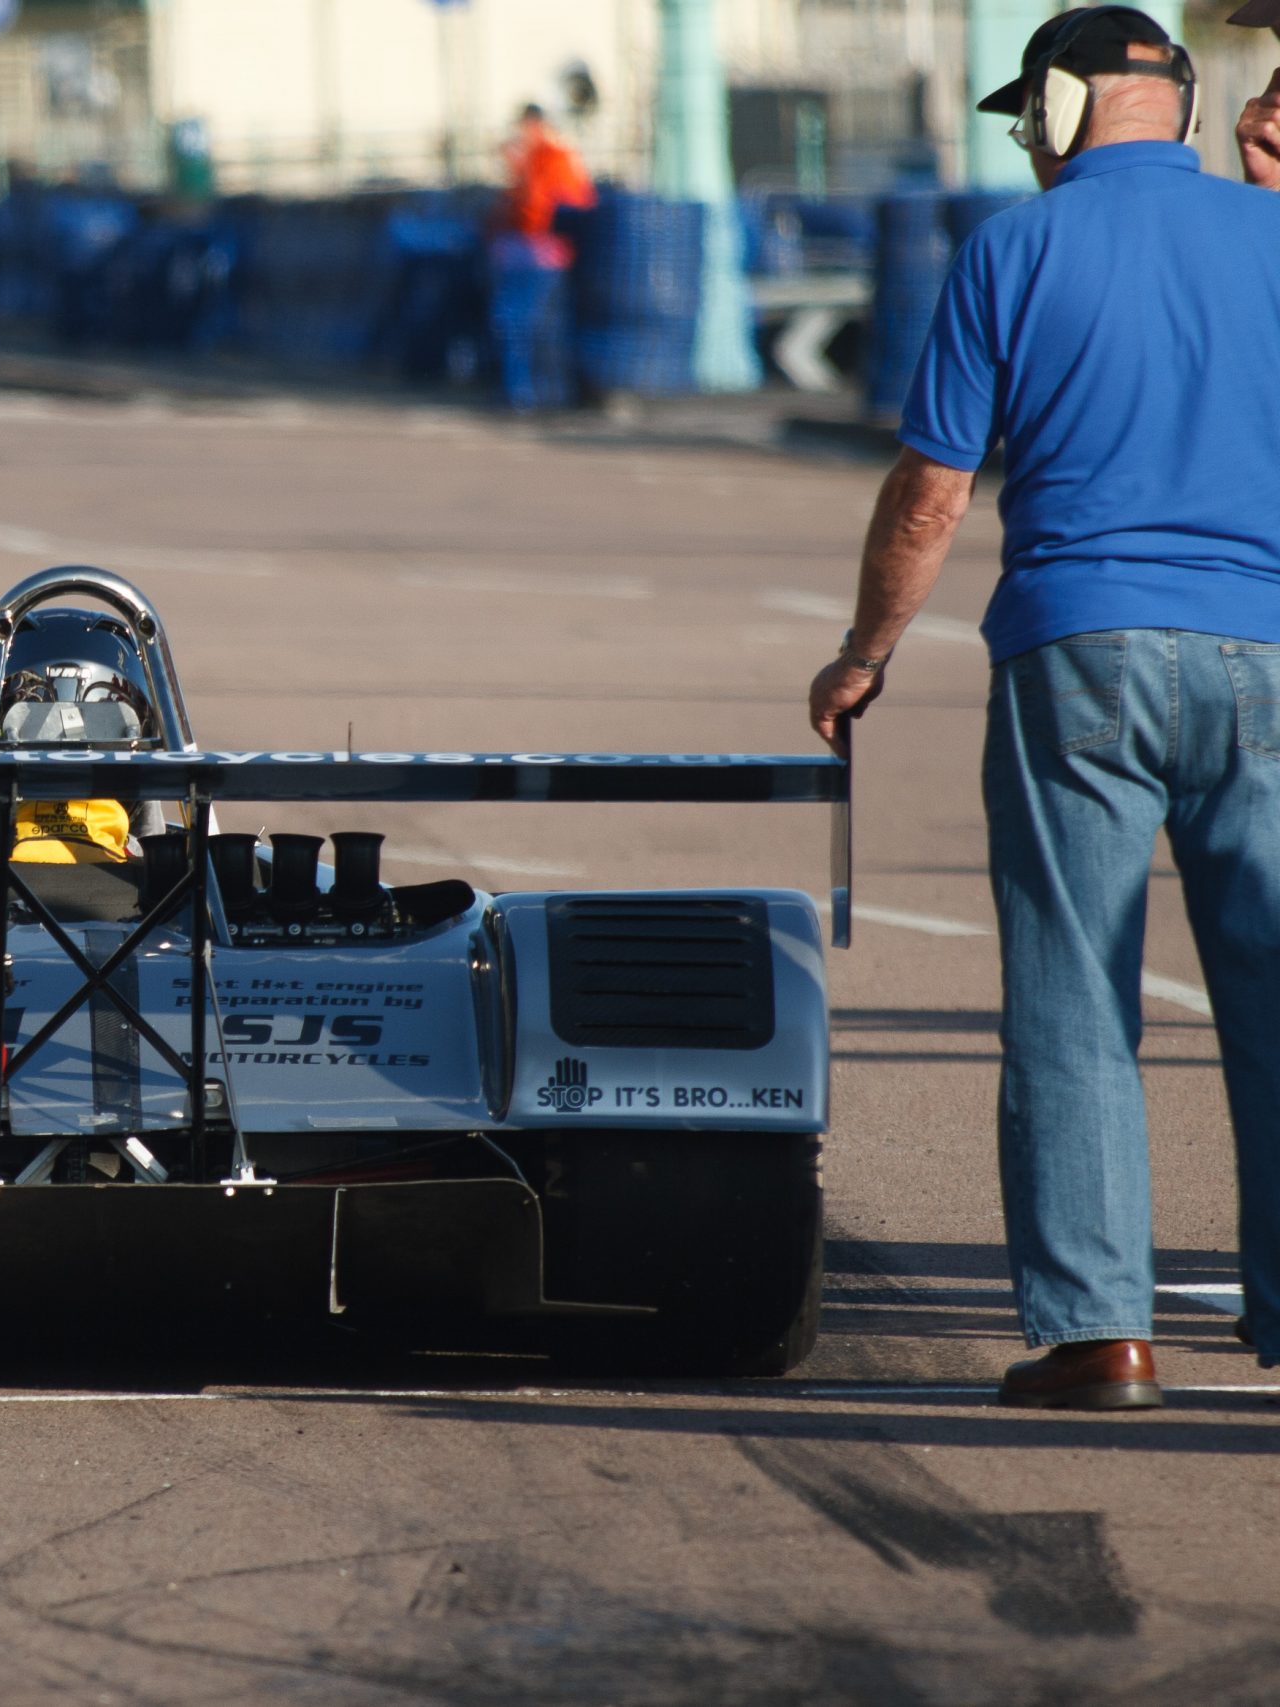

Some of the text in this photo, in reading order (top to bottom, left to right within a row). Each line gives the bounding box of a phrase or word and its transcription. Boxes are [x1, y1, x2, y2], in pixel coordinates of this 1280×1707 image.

[172, 978, 239, 990] St
[315, 981, 423, 994] engine
[174, 995, 423, 1010] peparation by
[222, 1014, 384, 1047] SJS
[536, 1087, 804, 1109] STOP IT'S BRO...KEN
